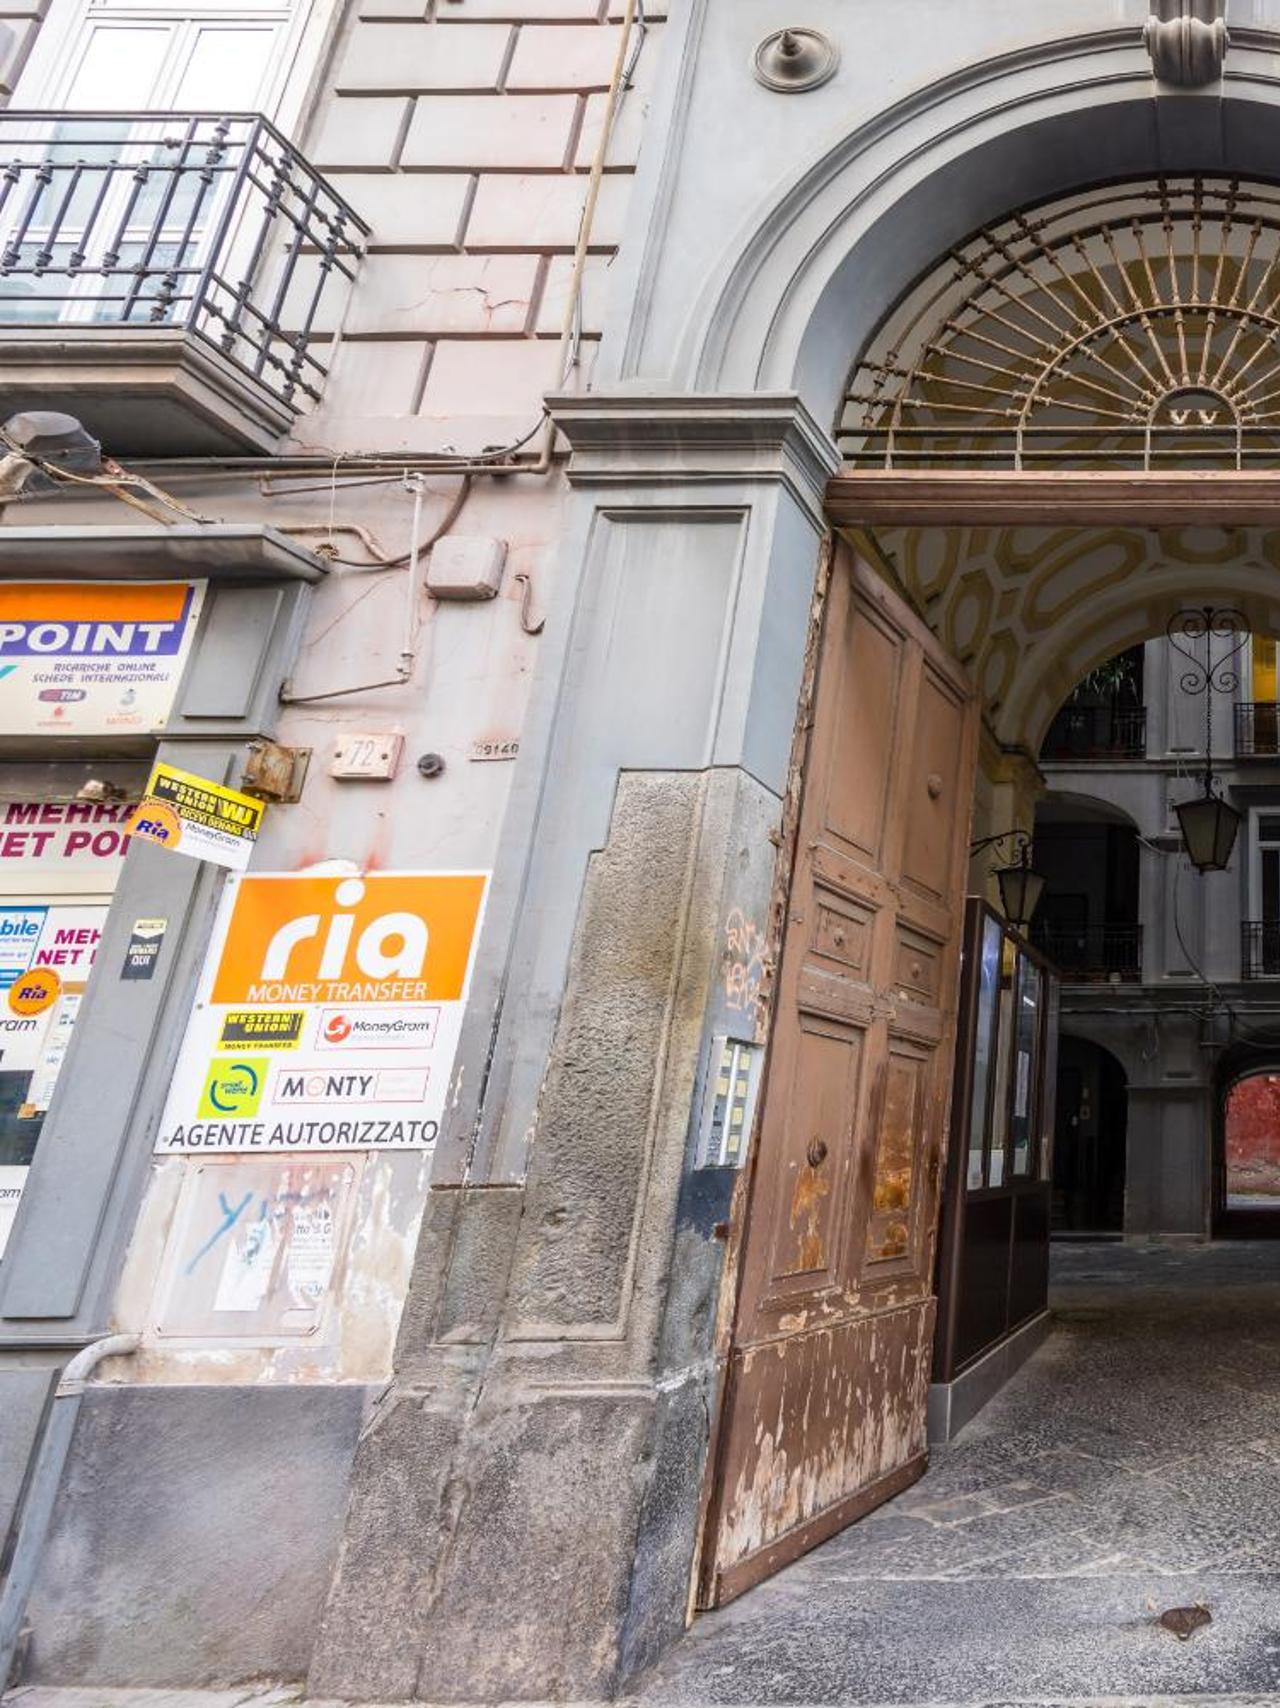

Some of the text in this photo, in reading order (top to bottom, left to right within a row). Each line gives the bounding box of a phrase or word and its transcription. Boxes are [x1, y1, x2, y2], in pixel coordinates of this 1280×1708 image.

[0, 623, 175, 653] POINT
[54, 663, 157, 672] RICARICHE ONLINE
[32, 673, 74, 683] SCHEDE
[350, 740, 375, 766] 72
[159, 777, 219, 805] WESTERN
[175, 793, 218, 813] UNION
[136, 819, 169, 839] Ria
[260, 878, 430, 981] ria
[18, 984, 48, 999] Ria
[248, 982, 430, 1001] MONEY TRANSFER
[223, 1013, 292, 1024] WESTERN
[244, 1023, 290, 1033] UNION
[352, 1019, 430, 1033] MoneyGram
[168, 1120, 438, 1147] AGENTE AUTORIZZATO
